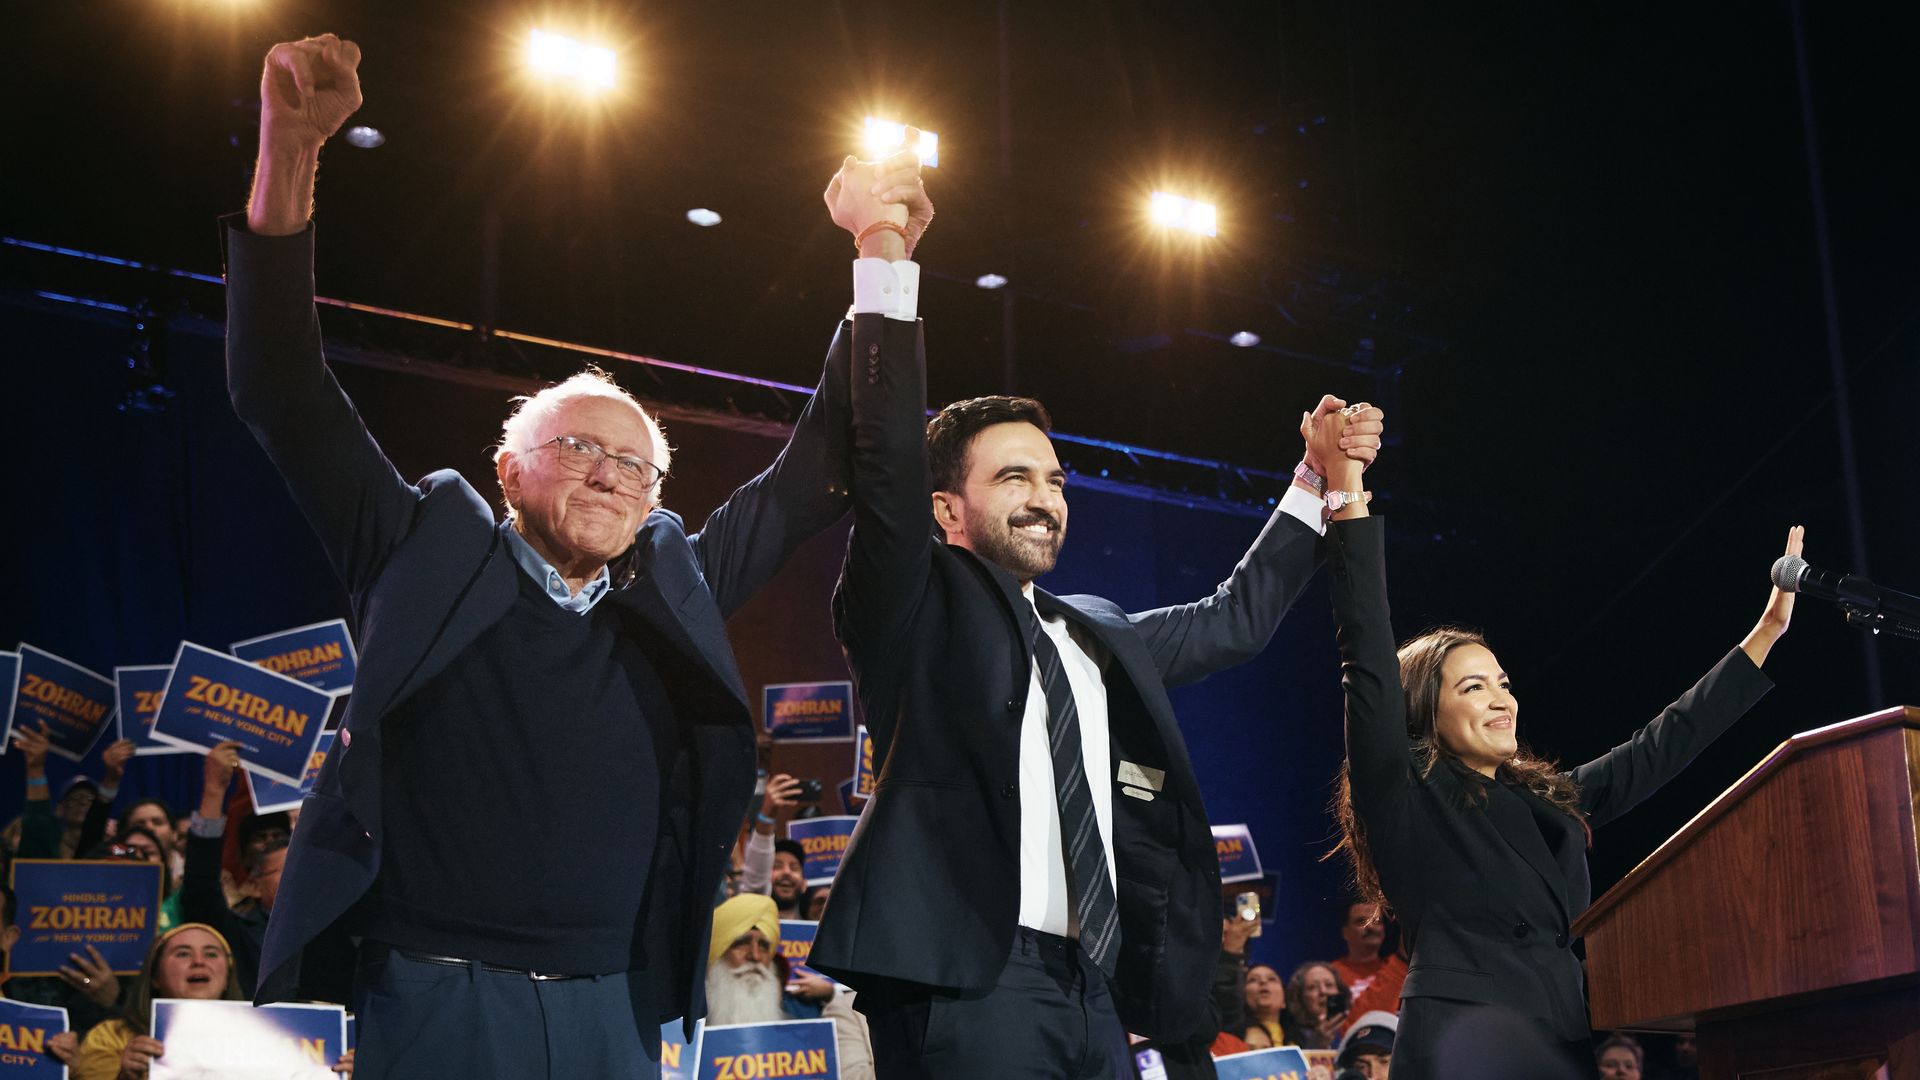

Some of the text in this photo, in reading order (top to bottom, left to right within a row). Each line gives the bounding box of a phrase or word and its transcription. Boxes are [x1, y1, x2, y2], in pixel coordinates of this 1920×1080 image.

[19, 673, 107, 724] ZOHRAN
[184, 675, 309, 737] ZOHRAN
[773, 699, 842, 717] ZOHRAN
[203, 708, 235, 726] NEW
[235, 715, 266, 736] YORK
[266, 729, 295, 748] CITY
[29, 905, 147, 930] ZOHRAN
[54, 933, 83, 943] NEW
[85, 933, 115, 943] YORK
[117, 933, 140, 943] CITY
[1, 1053, 37, 1067] CITY
[714, 1049, 828, 1080] ZOHRAN
